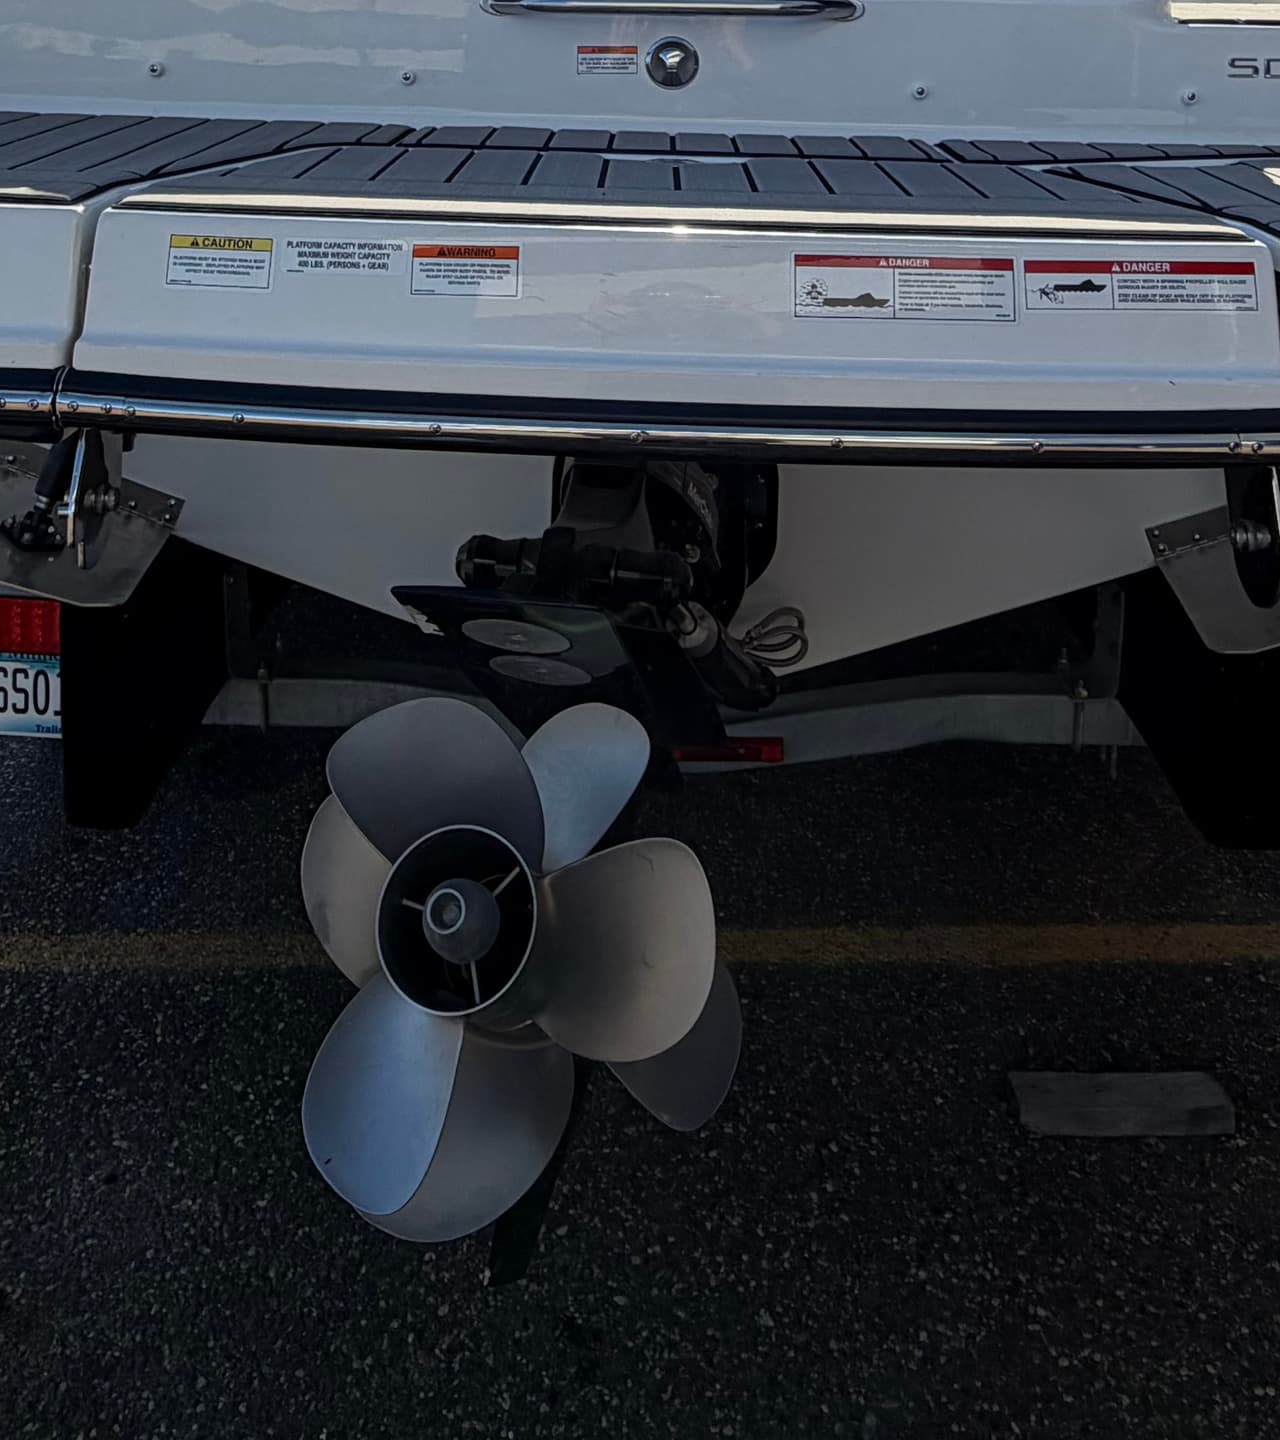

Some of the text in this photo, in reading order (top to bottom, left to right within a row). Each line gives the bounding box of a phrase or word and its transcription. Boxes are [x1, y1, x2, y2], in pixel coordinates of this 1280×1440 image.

[202, 237, 253, 249] CAUTION
[286, 240, 322, 249] PLATFORM
[323, 241, 357, 250] CAPACITY
[297, 250, 391, 260] MAXIMUM WEIGHT CAPACITY
[447, 247, 497, 257] WARNING
[888, 258, 929, 267] DANGER
[1122, 262, 1170, 272] DANGER
